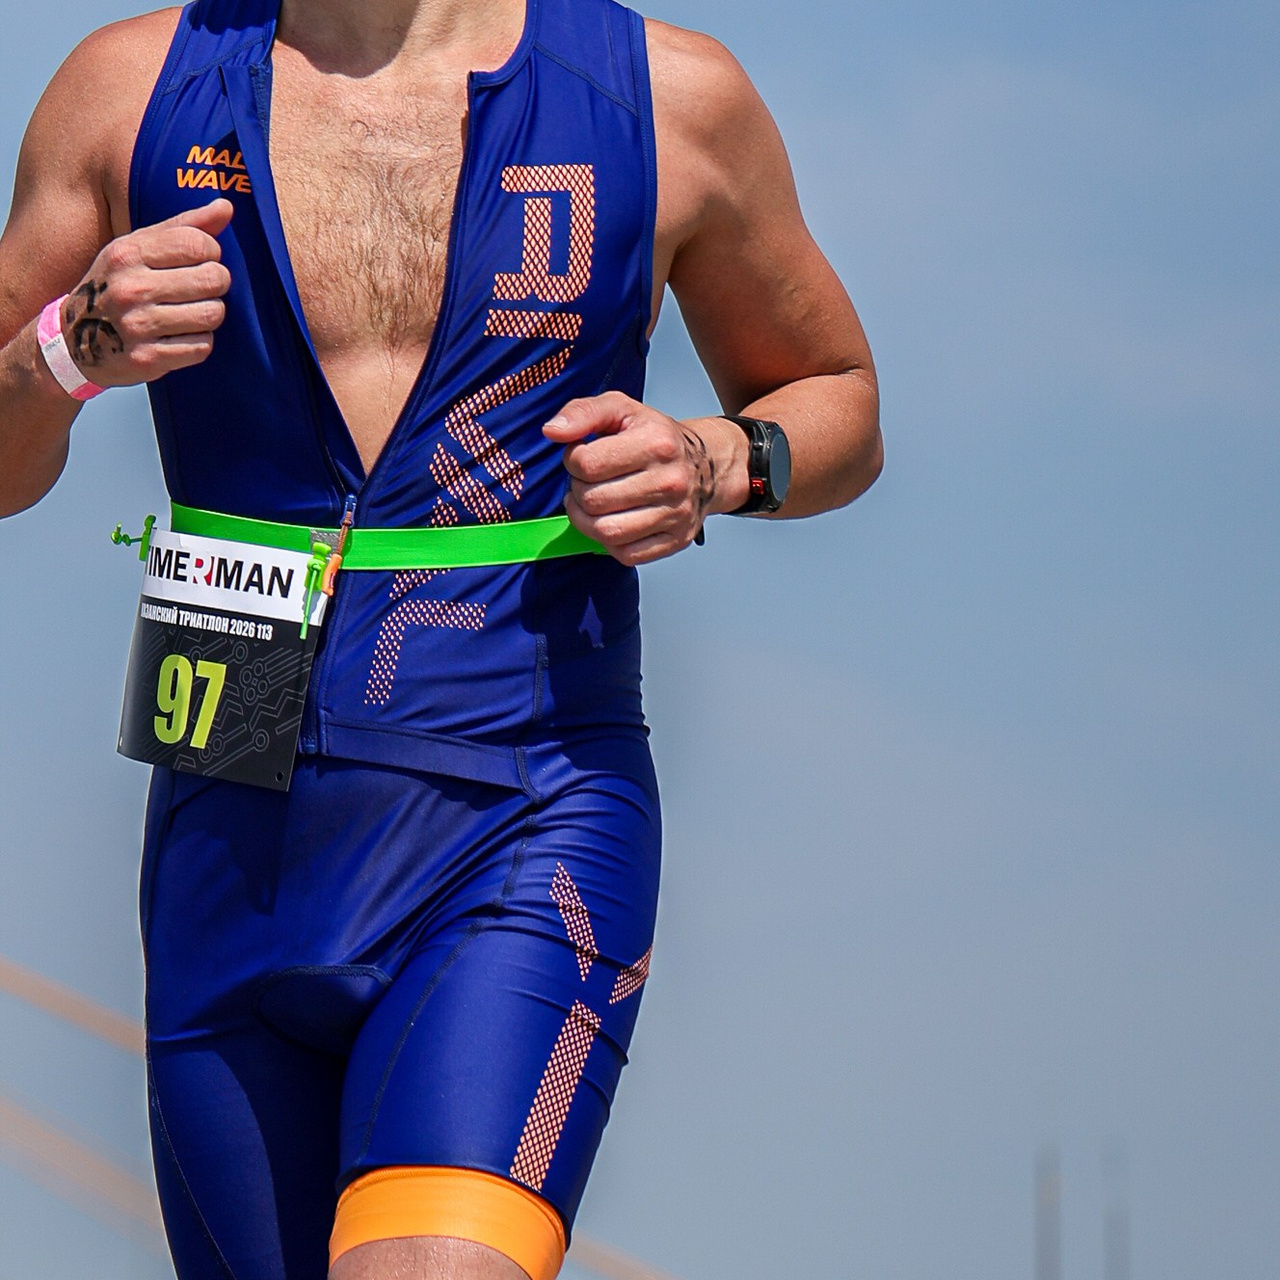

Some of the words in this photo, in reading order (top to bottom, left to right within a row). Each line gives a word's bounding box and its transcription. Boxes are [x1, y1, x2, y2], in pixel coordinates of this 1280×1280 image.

[176, 168, 252, 193] WAVE
[179, 611, 230, 633] ТРИАТЛОН
[230, 619, 255, 638] 2026
[256, 623, 274, 641] 113
[154, 653, 227, 750] 97
